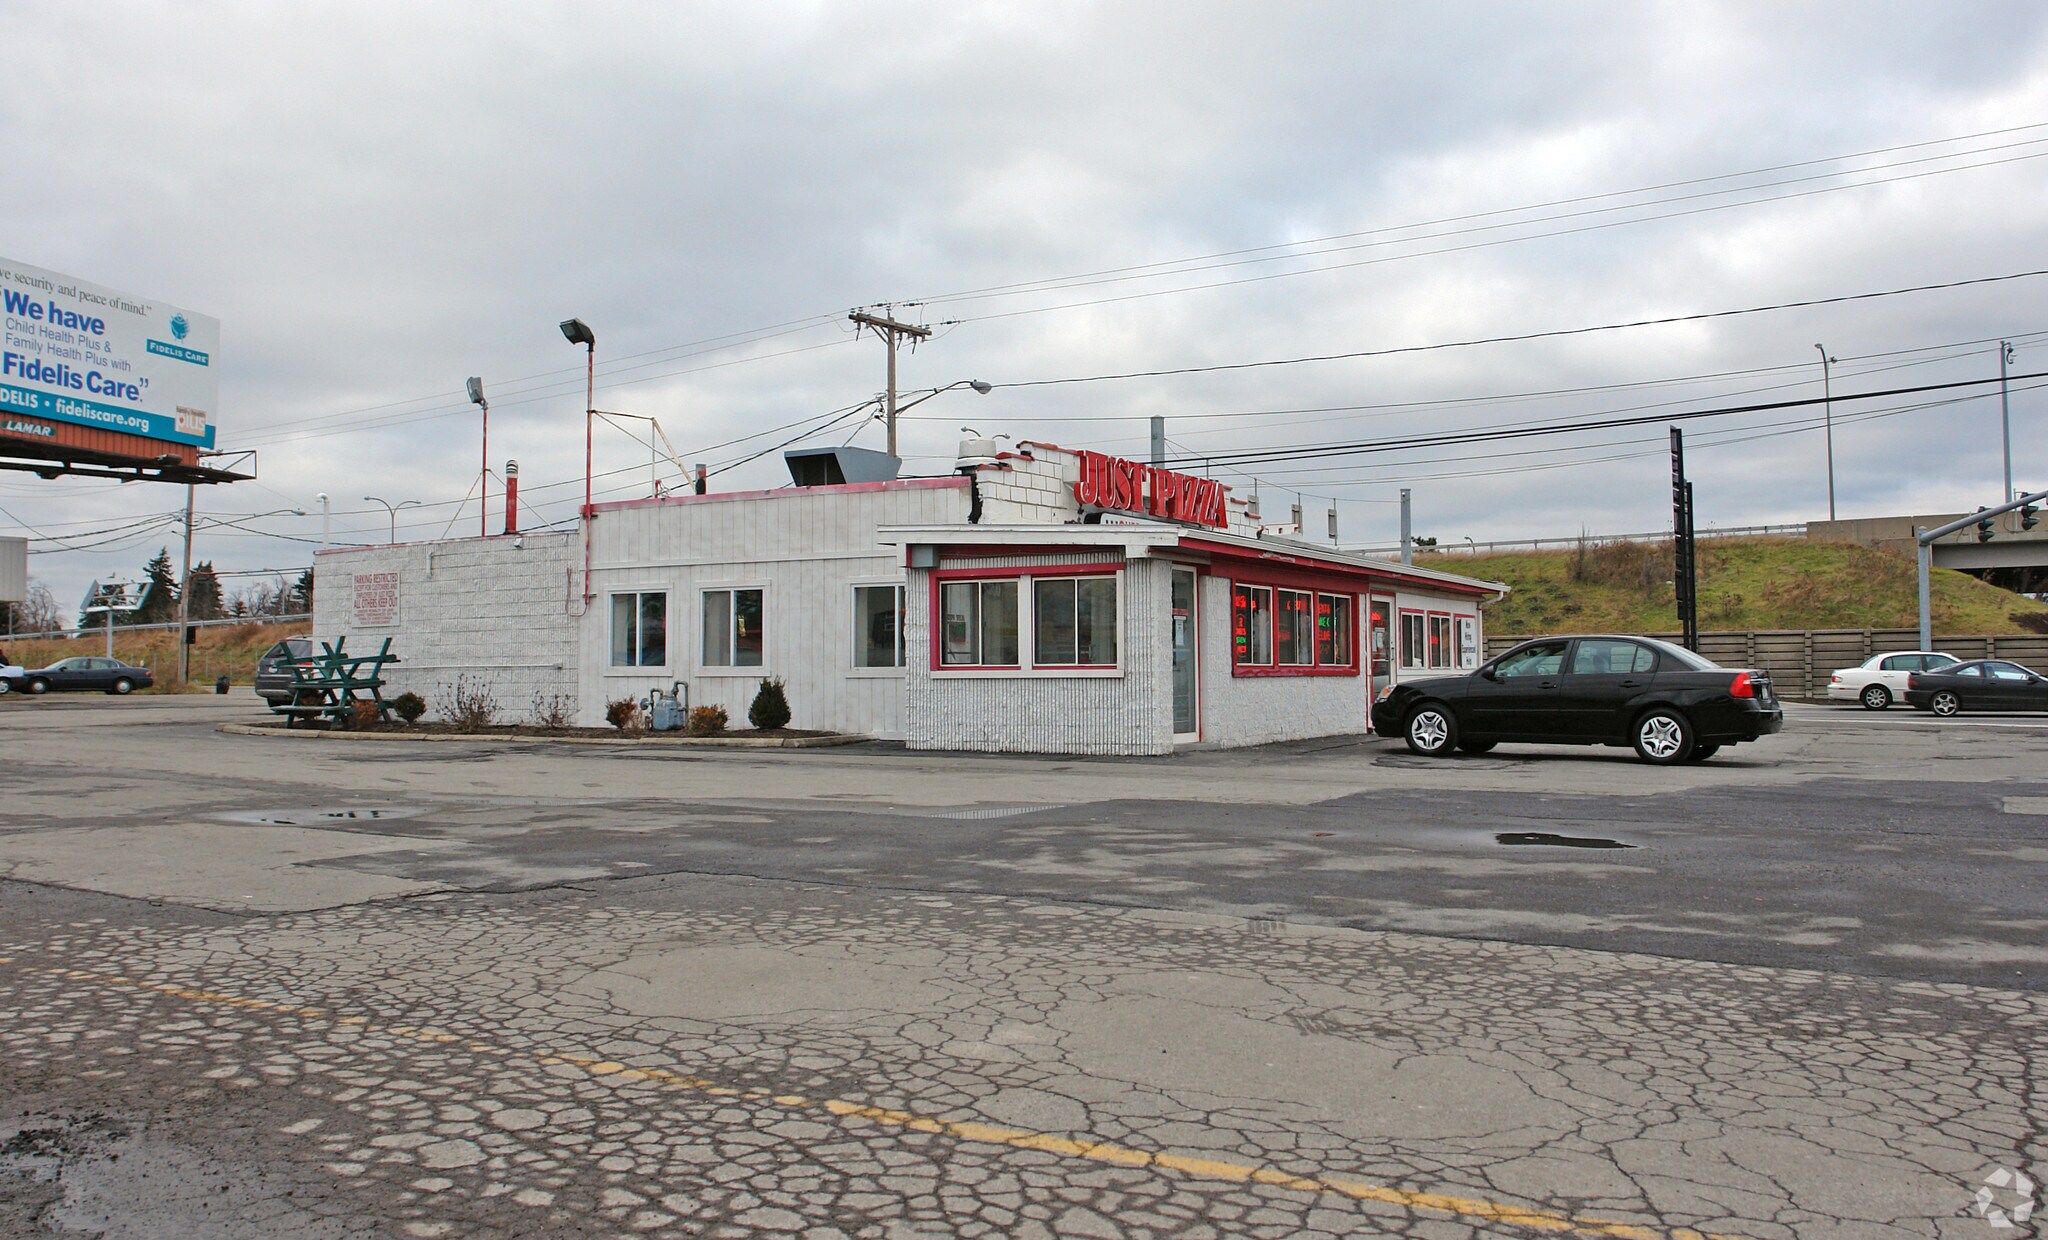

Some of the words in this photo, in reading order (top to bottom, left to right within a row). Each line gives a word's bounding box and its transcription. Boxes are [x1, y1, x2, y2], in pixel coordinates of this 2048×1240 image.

[14, 273, 54, 294] security
[58, 284, 76, 297] and
[79, 290, 107, 306] peace
[110, 297, 121, 309] of
[6, 317, 35, 335] Child
[39, 325, 75, 344] Health
[78, 334, 101, 351] Plus
[104, 340, 111, 353] &
[48, 300, 105, 336] have
[6, 332, 43, 355] Family
[47, 342, 82, 361] Health
[85, 351, 108, 367] Plus
[111, 359, 131, 372] with
[149, 342, 183, 358] FIDELIS
[3, 351, 83, 390] Fidelis
[6, 420, 52, 437] LAMAR
[56, 398, 149, 433] fideliscare.org
[1074, 450, 1147, 513] JUST
[1148, 467, 1228, 529] PIZZA
